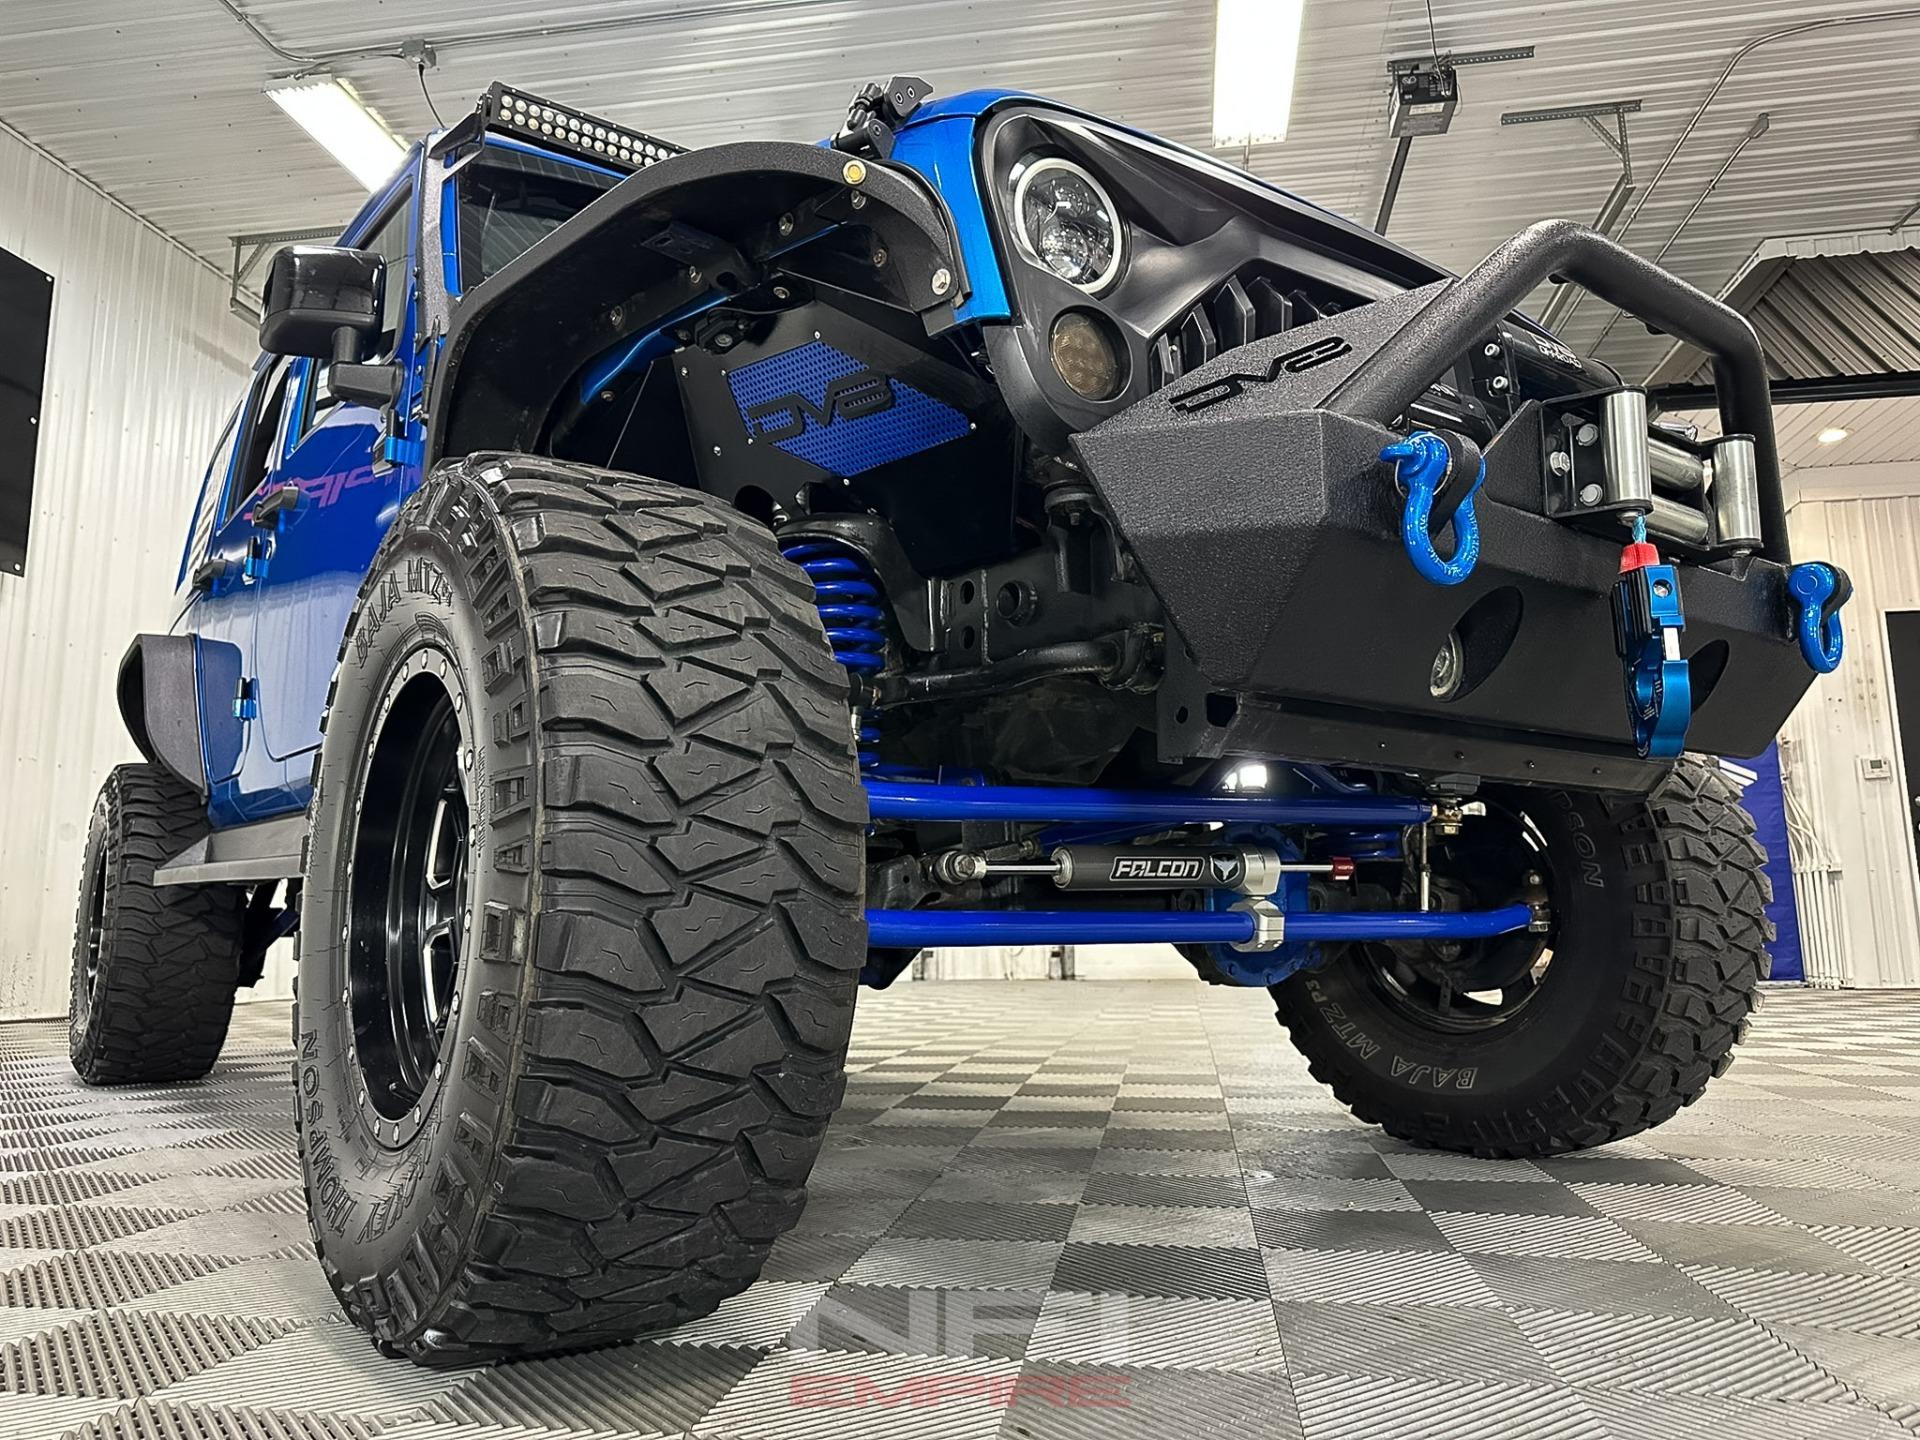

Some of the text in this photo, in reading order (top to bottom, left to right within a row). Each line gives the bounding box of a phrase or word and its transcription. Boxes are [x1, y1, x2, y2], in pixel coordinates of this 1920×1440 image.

[356, 570, 401, 670] BAJA
[1115, 860, 1199, 877] FALCON
[1390, 1055, 1478, 1089] BAJA
[300, 1029, 358, 1238] THOMPSON
